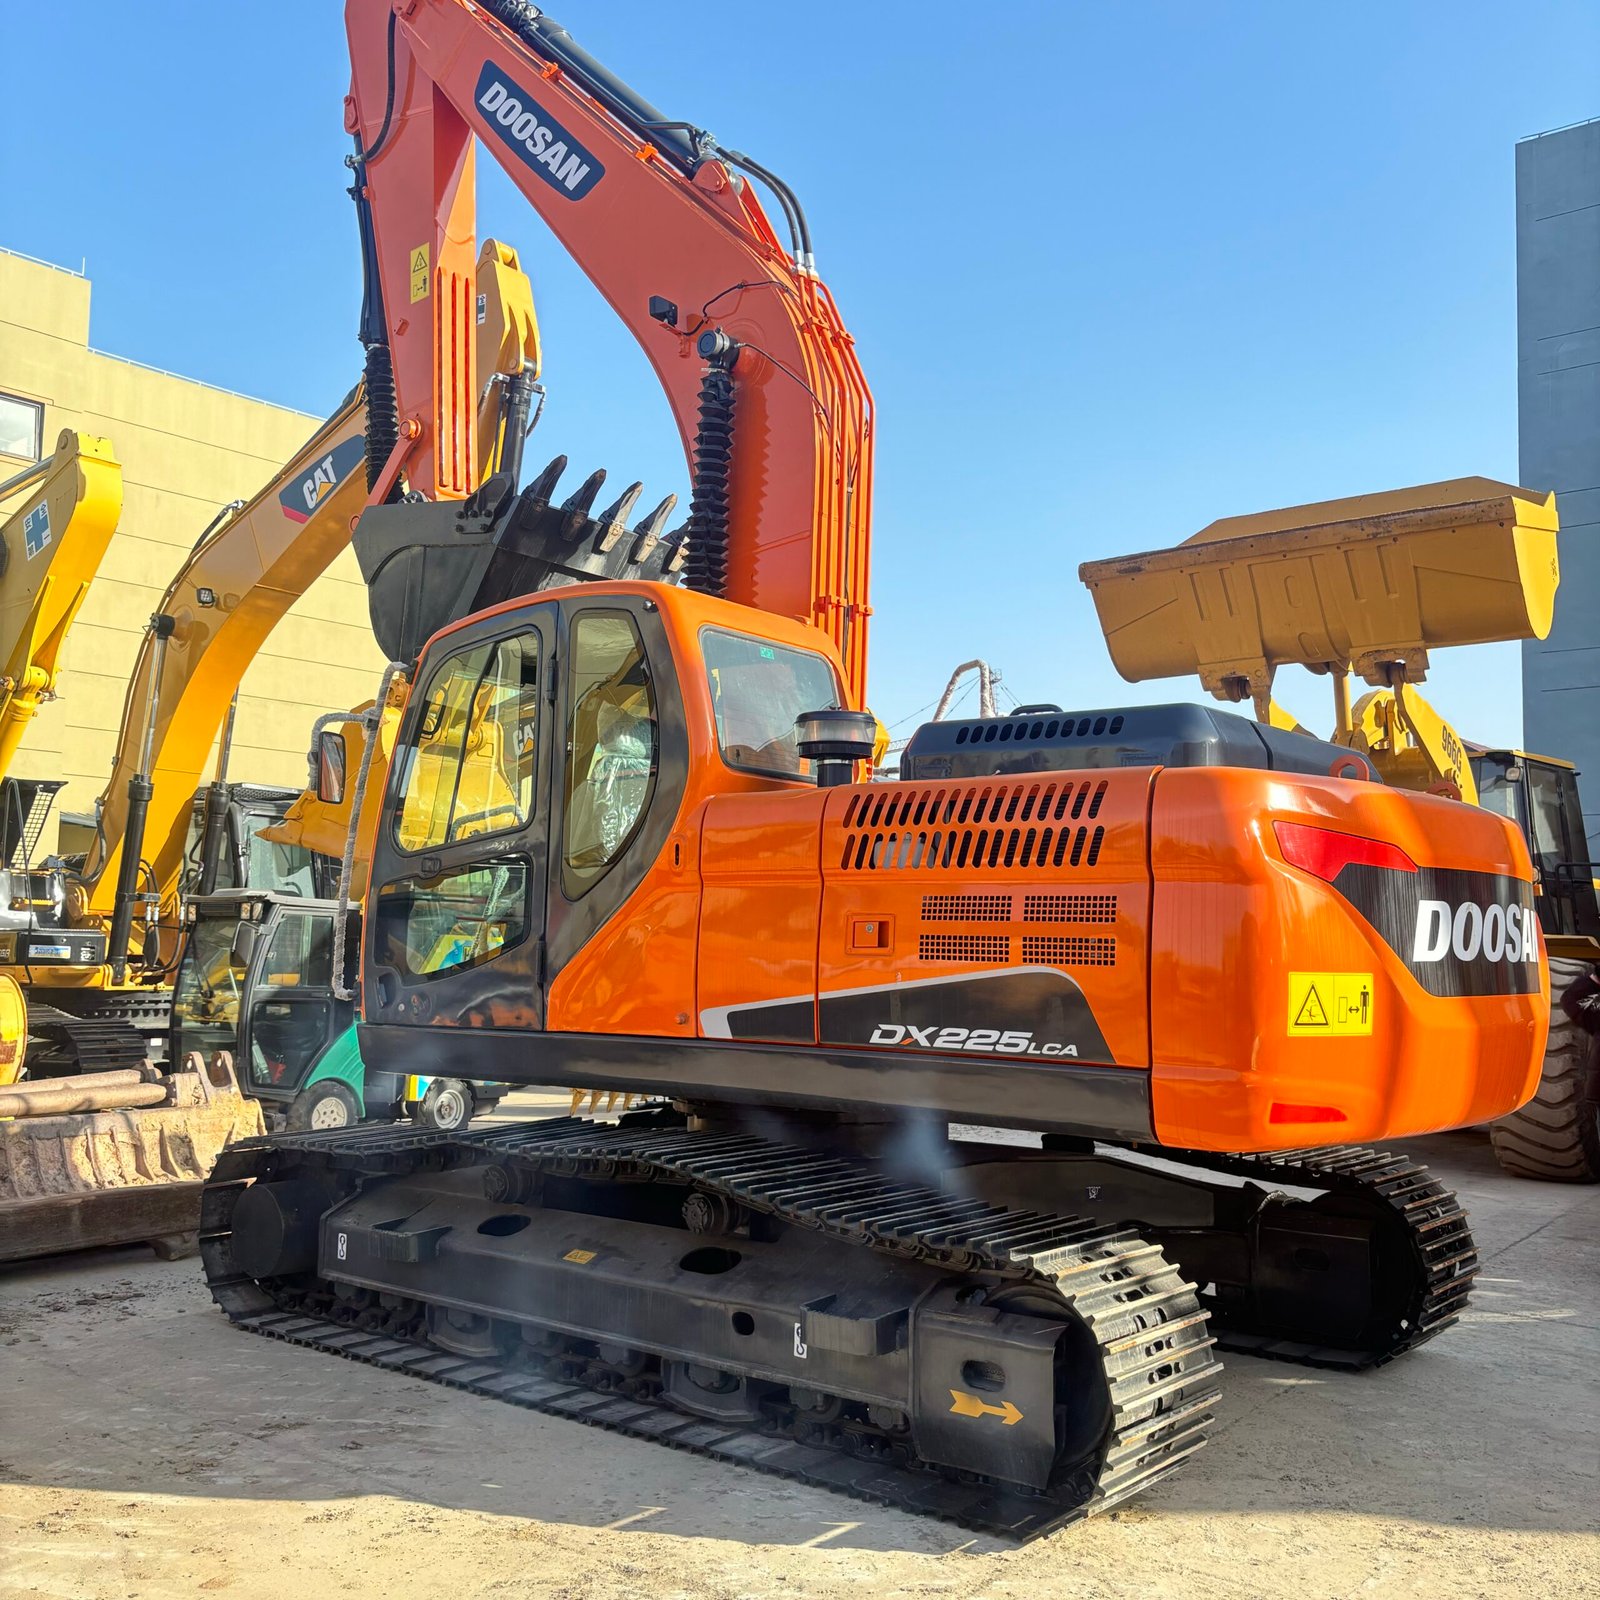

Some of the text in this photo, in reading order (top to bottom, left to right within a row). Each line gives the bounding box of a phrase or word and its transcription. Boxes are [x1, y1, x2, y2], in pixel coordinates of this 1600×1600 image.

[479, 81, 590, 191] DOOSAN
[302, 454, 337, 509] CAT
[512, 721, 535, 756] CA
[1442, 724, 1462, 775] 966G
